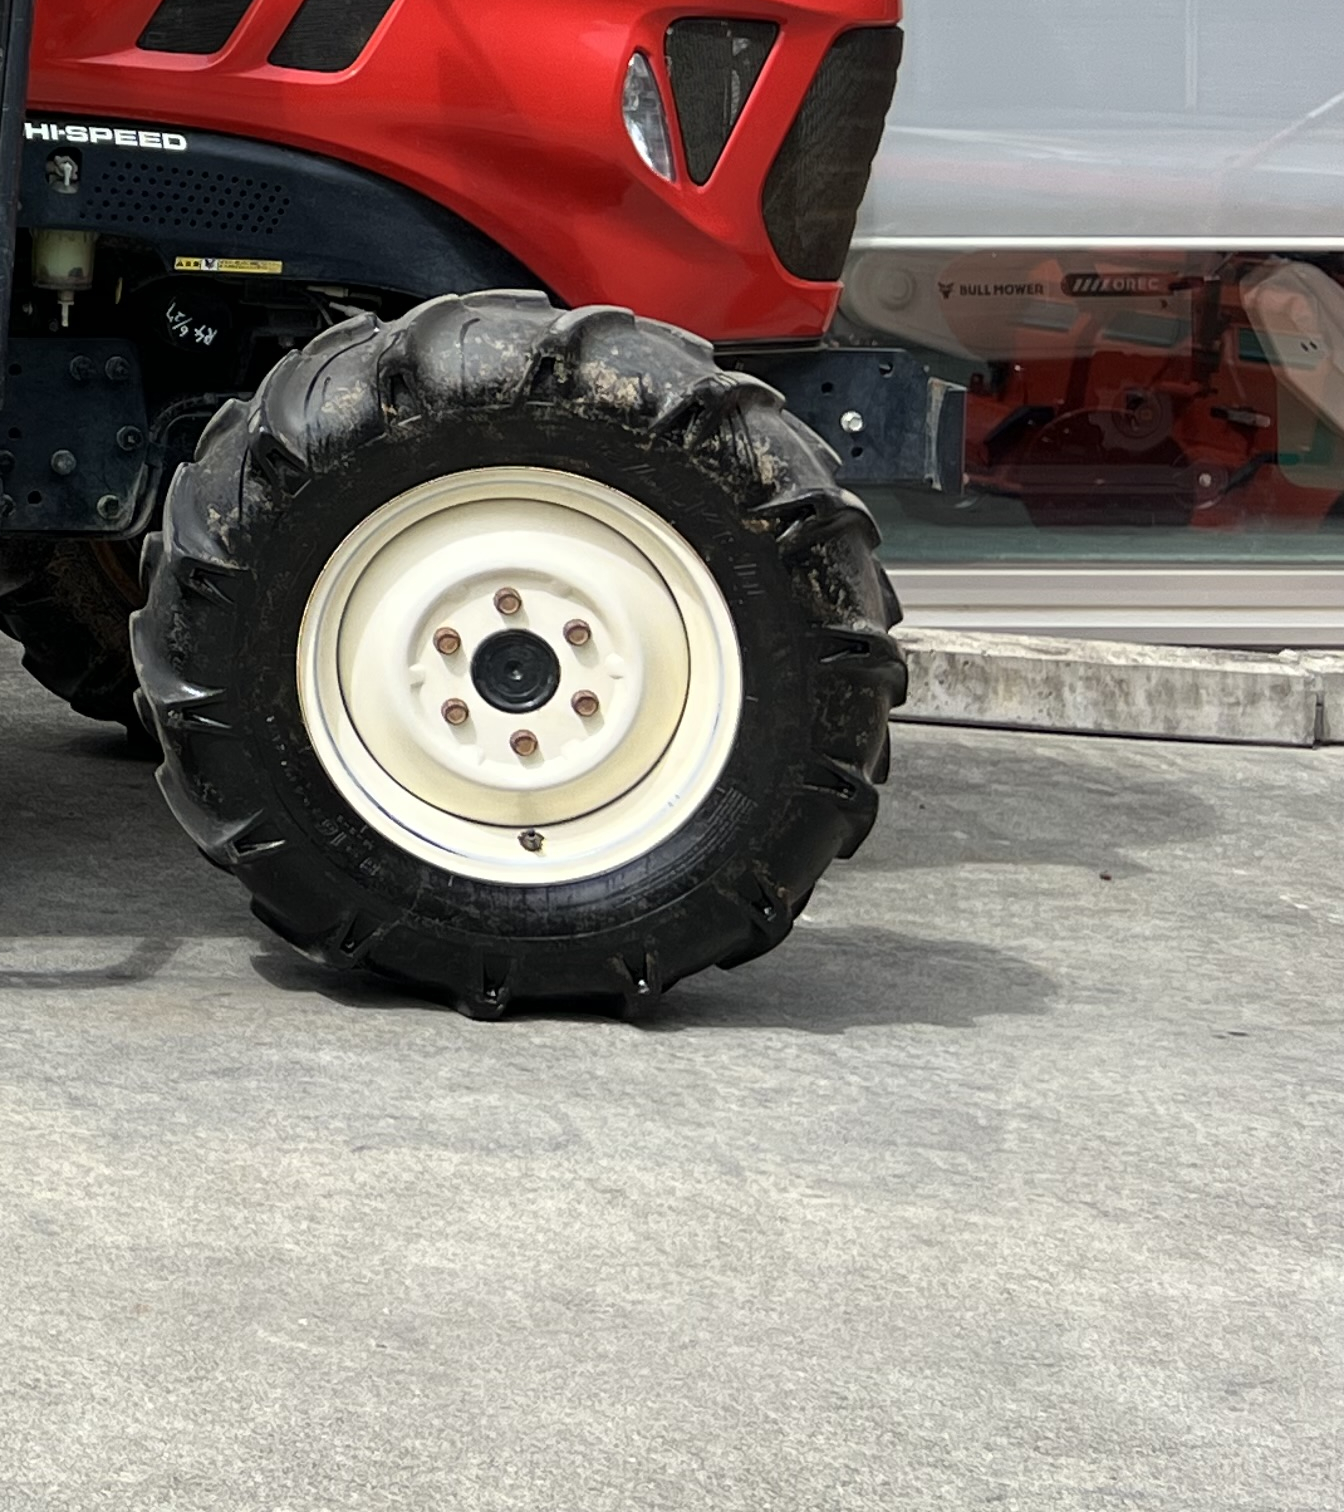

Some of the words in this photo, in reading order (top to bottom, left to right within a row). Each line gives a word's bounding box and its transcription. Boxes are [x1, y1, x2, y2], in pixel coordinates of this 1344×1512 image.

[23, 122, 187, 151] HI-SPEED
[959, 284, 992, 296] BULL
[993, 283, 1044, 296] MOWER
[1113, 277, 1160, 290] OREC
